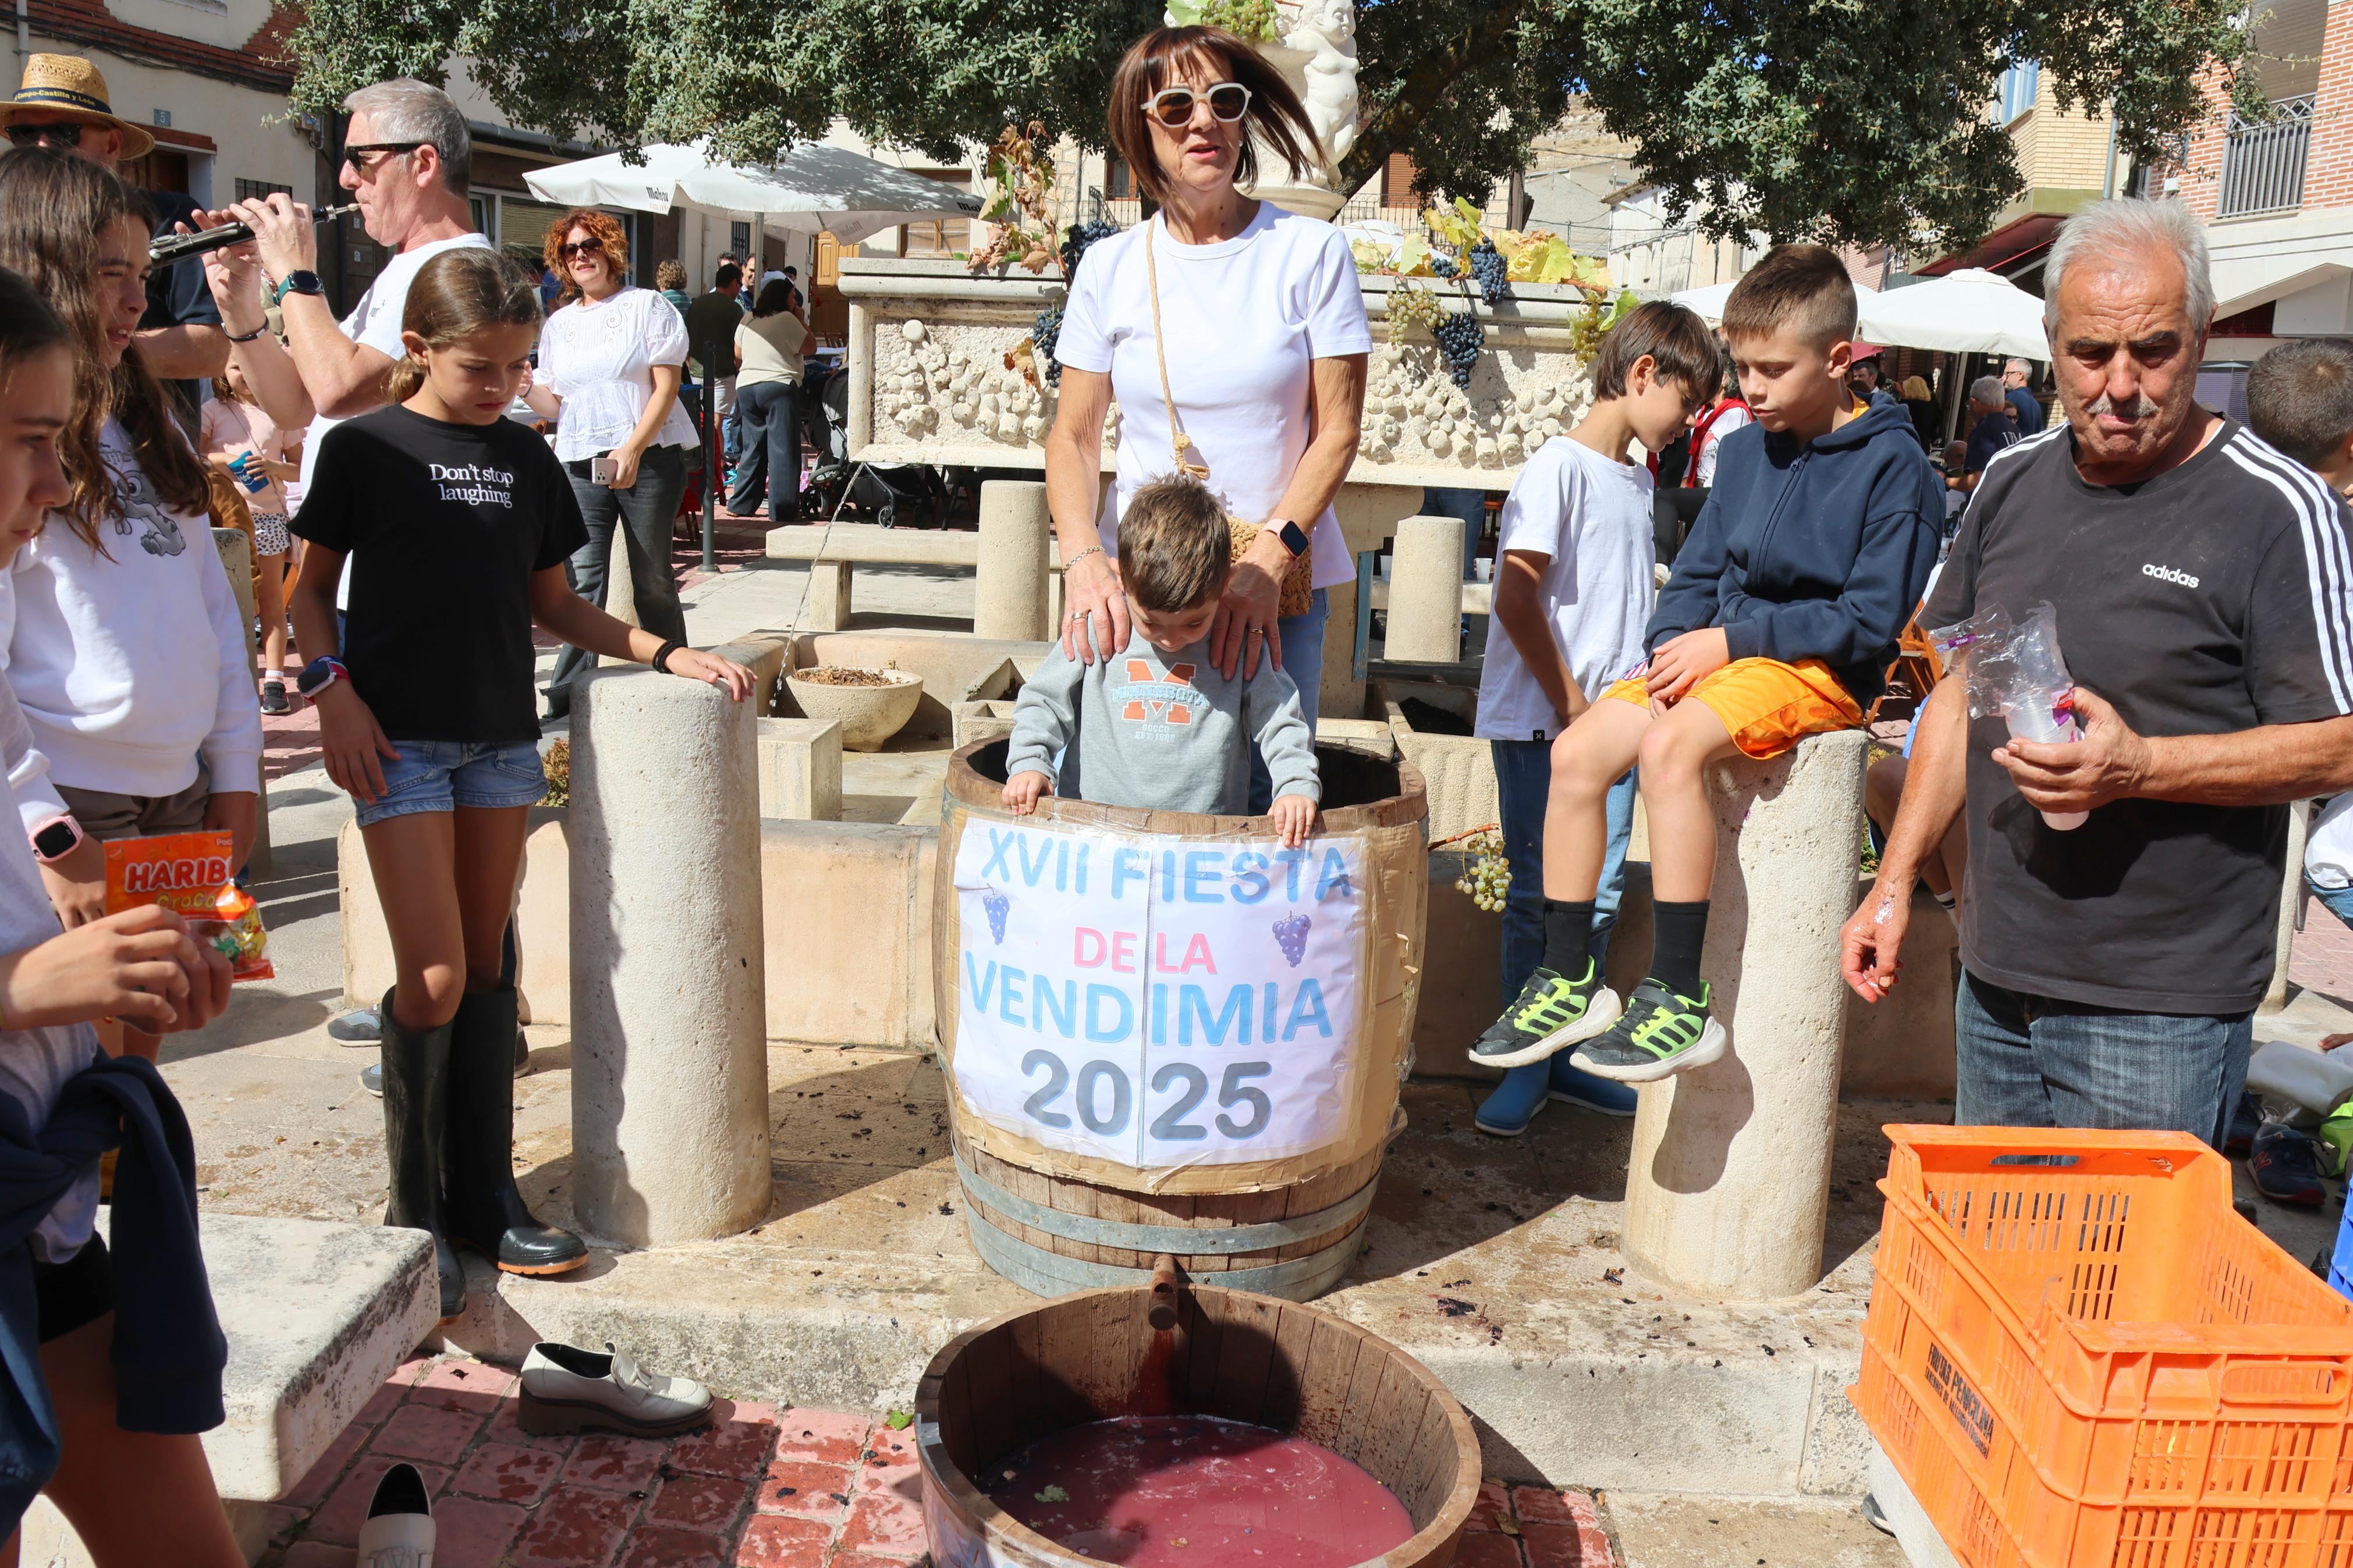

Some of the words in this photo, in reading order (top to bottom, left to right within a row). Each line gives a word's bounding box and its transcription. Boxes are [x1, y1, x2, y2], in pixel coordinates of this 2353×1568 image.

[17, 90, 70, 99] Campo-Castilla
[79, 95, 95, 106] León
[159, 111, 166, 123] 5
[646, 186, 669, 202] Mahou
[428, 463, 481, 481] Don't
[482, 467, 513, 488] stop
[438, 483, 513, 508] laughing
[2142, 564, 2199, 588] adidas
[1111, 684, 1210, 707] MINNESOTA
[216, 837, 232, 847] Poc
[981, 827, 1089, 895] XVII
[1110, 847, 1351, 904] FIESTA
[1074, 926, 1137, 973] DE
[1155, 932, 1218, 975] LA
[965, 951, 1333, 1046] VENDIMIA
[1021, 1049, 1272, 1142] 2025
[1927, 1341, 1953, 1386] FRUTAS
